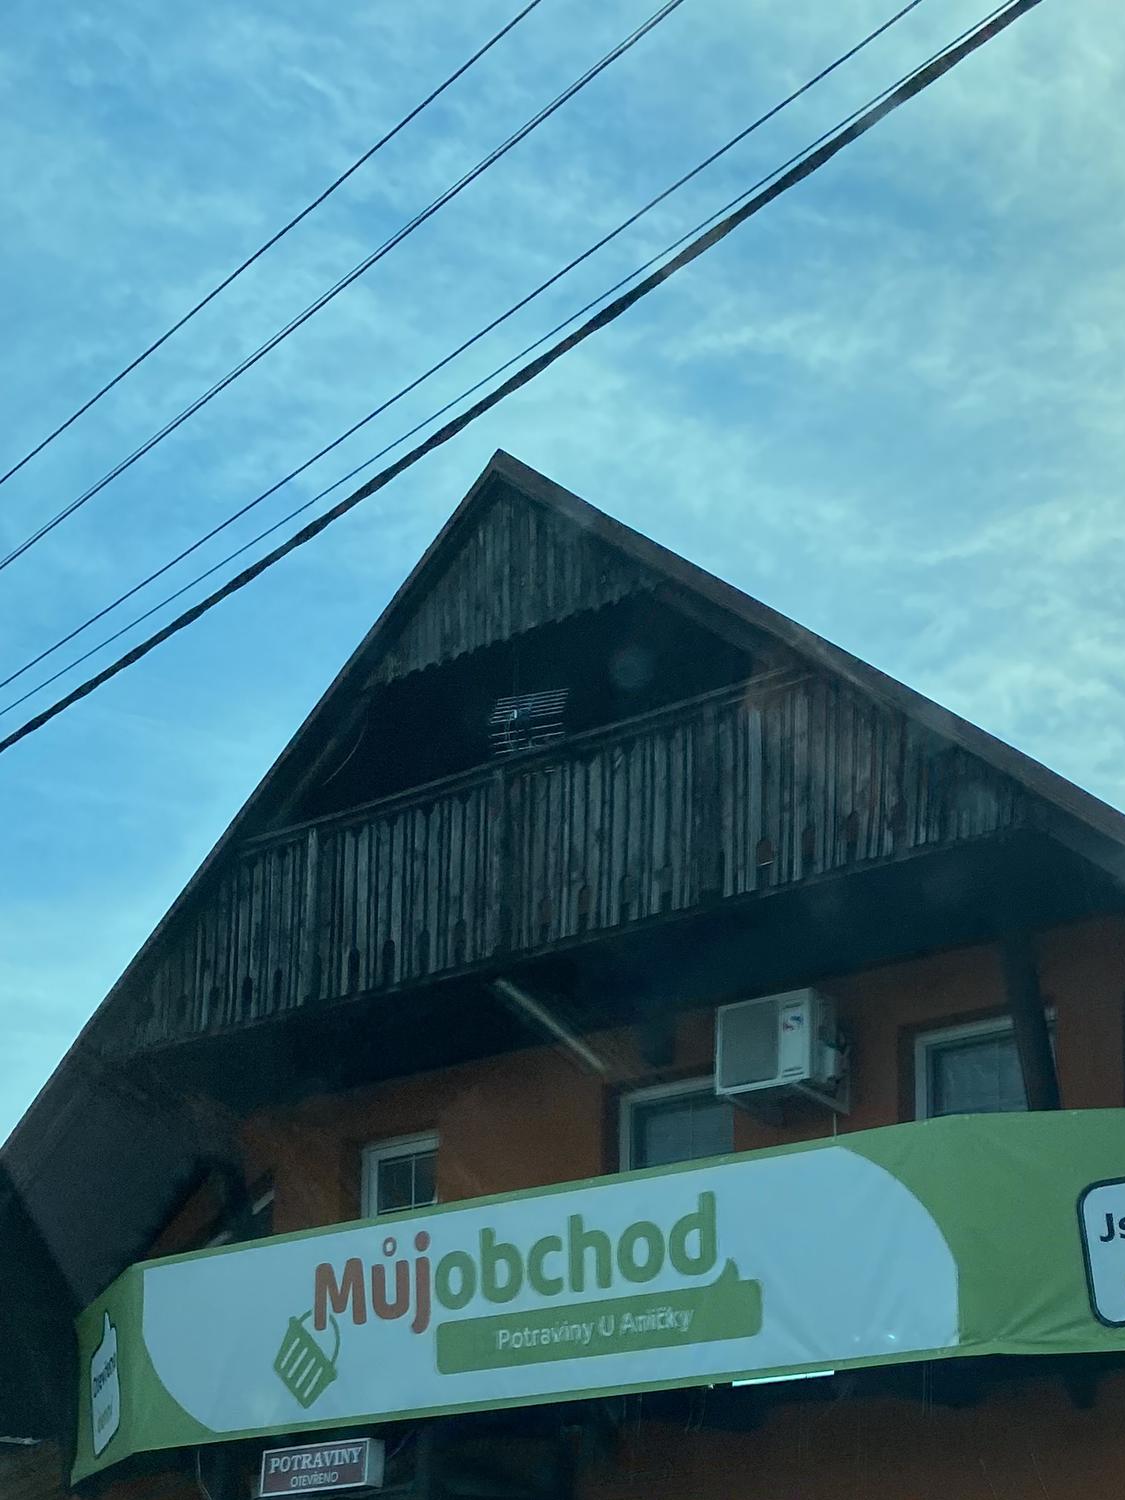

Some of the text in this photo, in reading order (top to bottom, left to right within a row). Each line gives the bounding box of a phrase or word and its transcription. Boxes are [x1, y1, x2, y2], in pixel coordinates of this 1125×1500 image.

[497, 1320, 595, 1350] Potraviny
[600, 1314, 615, 1337] U
[269, 1447, 363, 1474] POTRAVINY
[290, 1471, 339, 1488] OTEVŘENO
